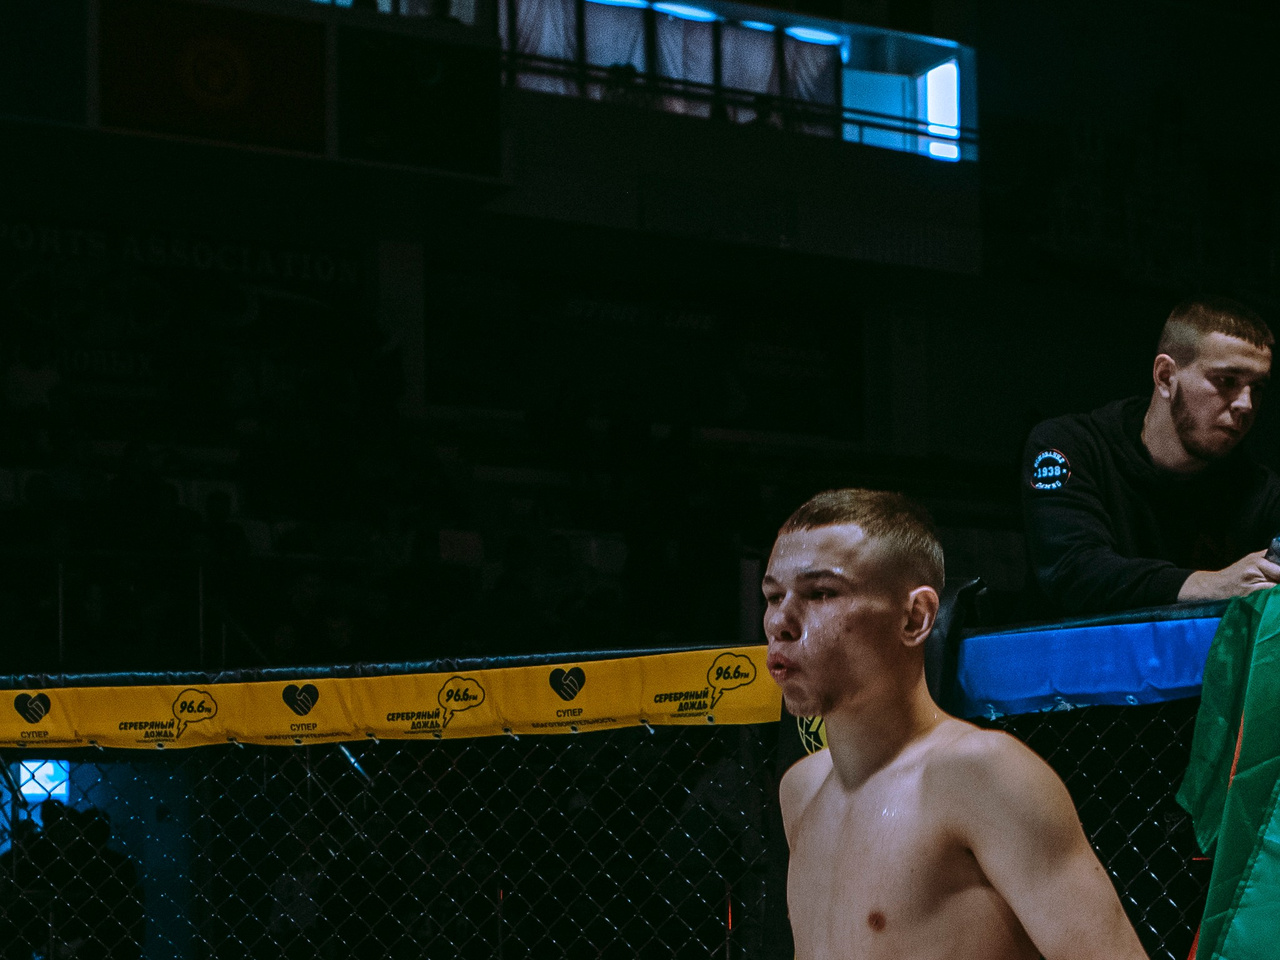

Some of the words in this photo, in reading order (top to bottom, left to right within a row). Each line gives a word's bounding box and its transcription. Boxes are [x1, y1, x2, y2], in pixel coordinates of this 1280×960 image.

[1037, 465, 1061, 478] 1938
[654, 687, 709, 703] СЕРЕБРЯНЫЙ
[678, 701, 708, 712] ДОЖДЬ
[386, 708, 440, 721] СЕРЕБРЯНЫЙ
[556, 708, 584, 717] СУПЕР
[118, 718, 175, 731] СЕРЕБРЯНЫЙ
[290, 723, 318, 731] СУПЕР
[411, 721, 441, 730] ДОЖДЬ
[21, 730, 49, 739] СУПЕР
[144, 730, 175, 739] ДОЖДЬ
